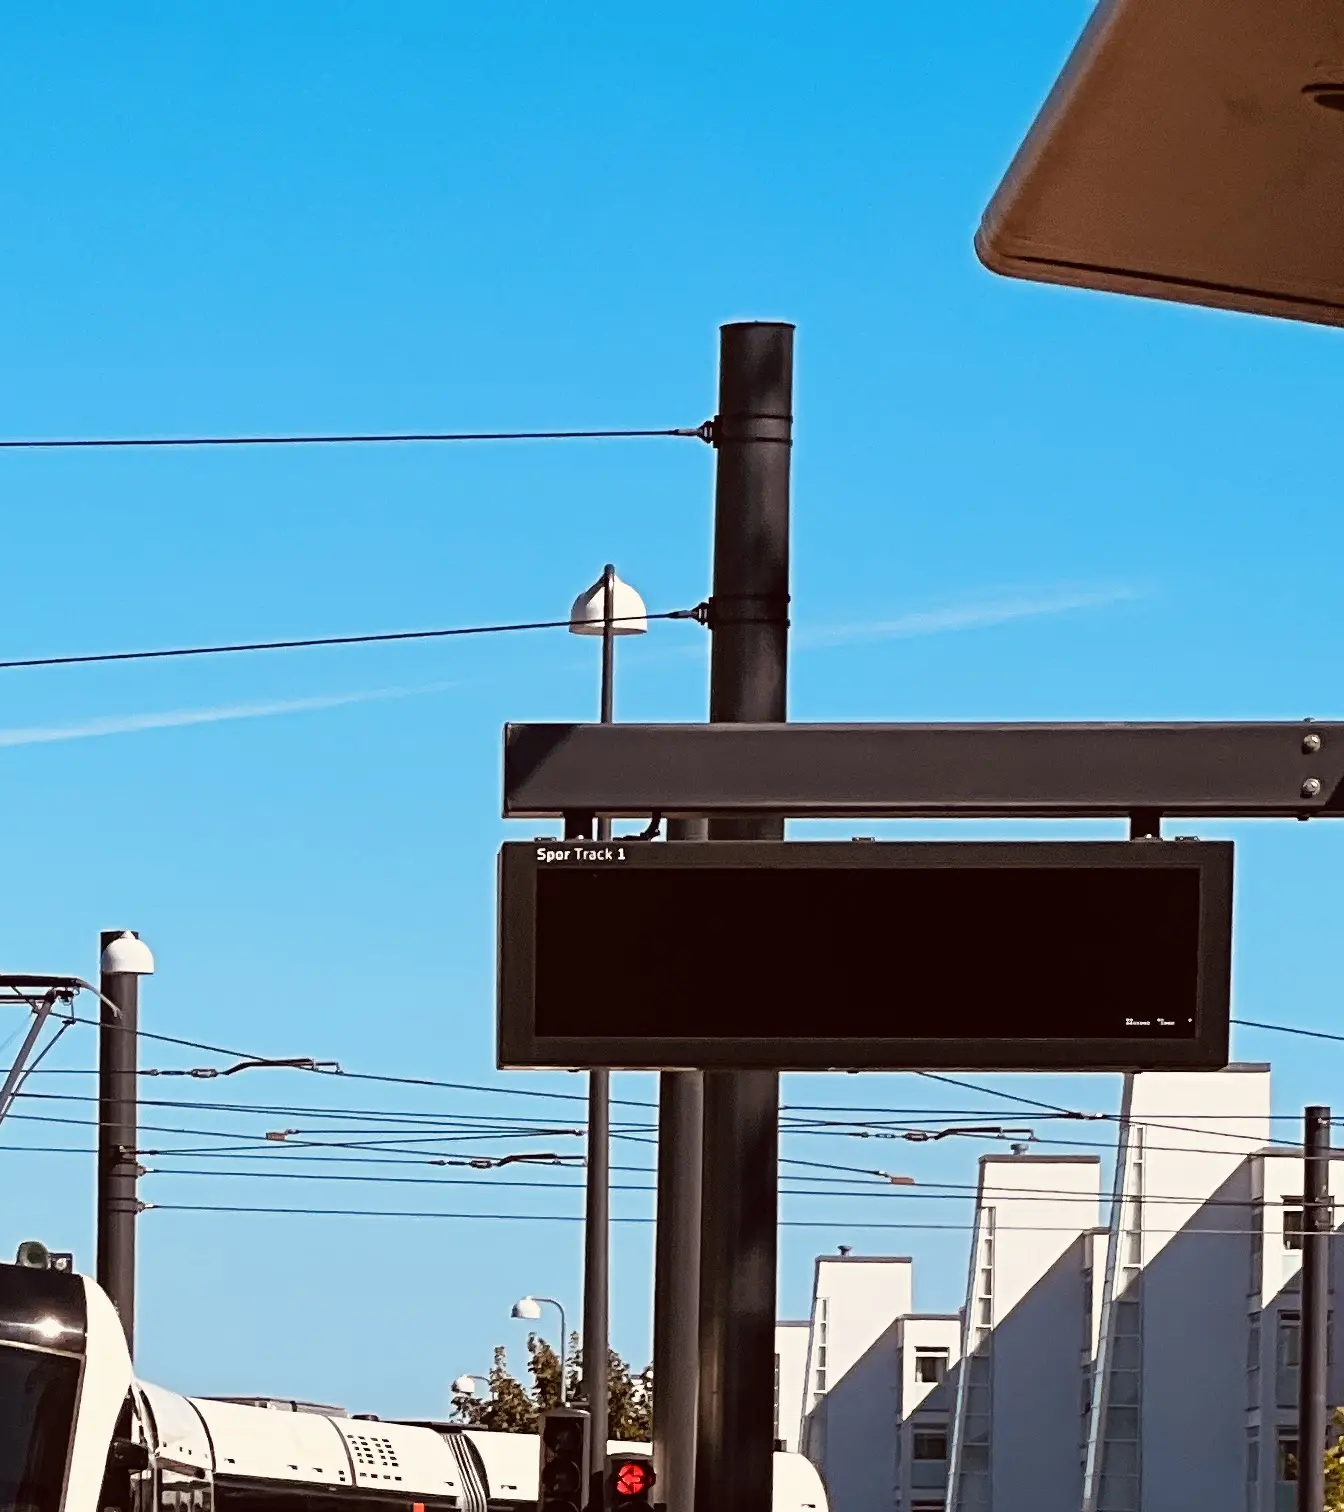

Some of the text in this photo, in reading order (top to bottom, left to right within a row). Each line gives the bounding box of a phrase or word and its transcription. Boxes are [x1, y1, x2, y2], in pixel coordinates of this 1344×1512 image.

[536, 847, 626, 863] Spor Track 1
